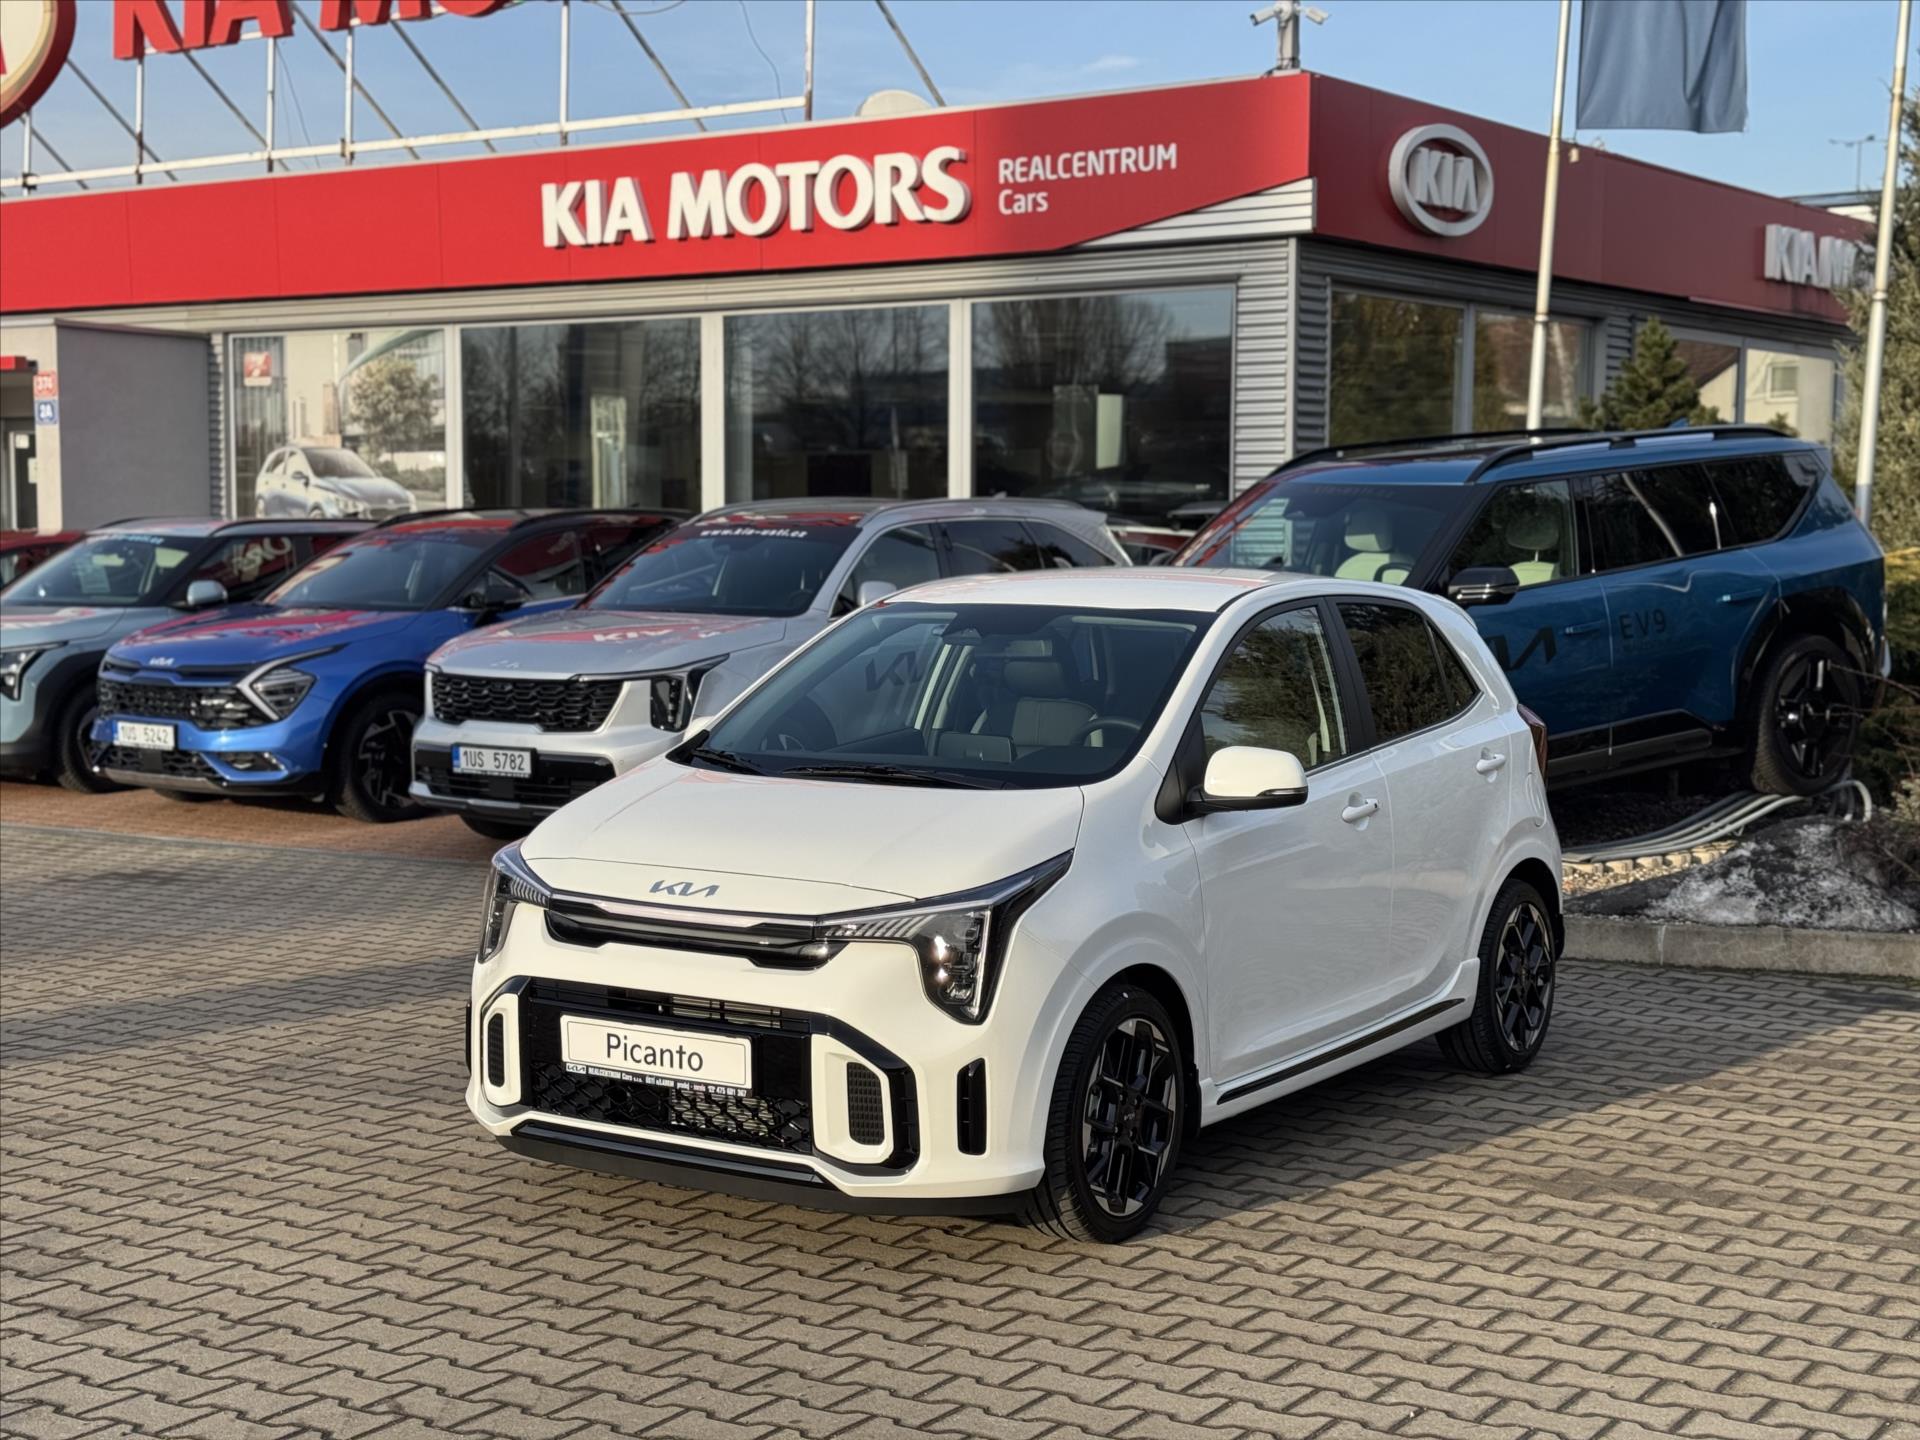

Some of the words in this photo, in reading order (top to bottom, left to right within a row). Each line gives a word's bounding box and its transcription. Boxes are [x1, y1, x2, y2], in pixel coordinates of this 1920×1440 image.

[998, 142, 1178, 185] REALCENTRUM
[1409, 147, 1478, 213] KIA
[541, 176, 652, 248] KIA
[667, 145, 969, 241] MOTORS
[998, 189, 1049, 216] Cars
[1764, 223, 1819, 286] KIA
[1619, 608, 1667, 640] EV9
[143, 726, 169, 744] 5242
[463, 749, 485, 768] 1US
[493, 751, 525, 772] 5782
[649, 879, 720, 898] KIA
[606, 1032, 704, 1072] Picanto
